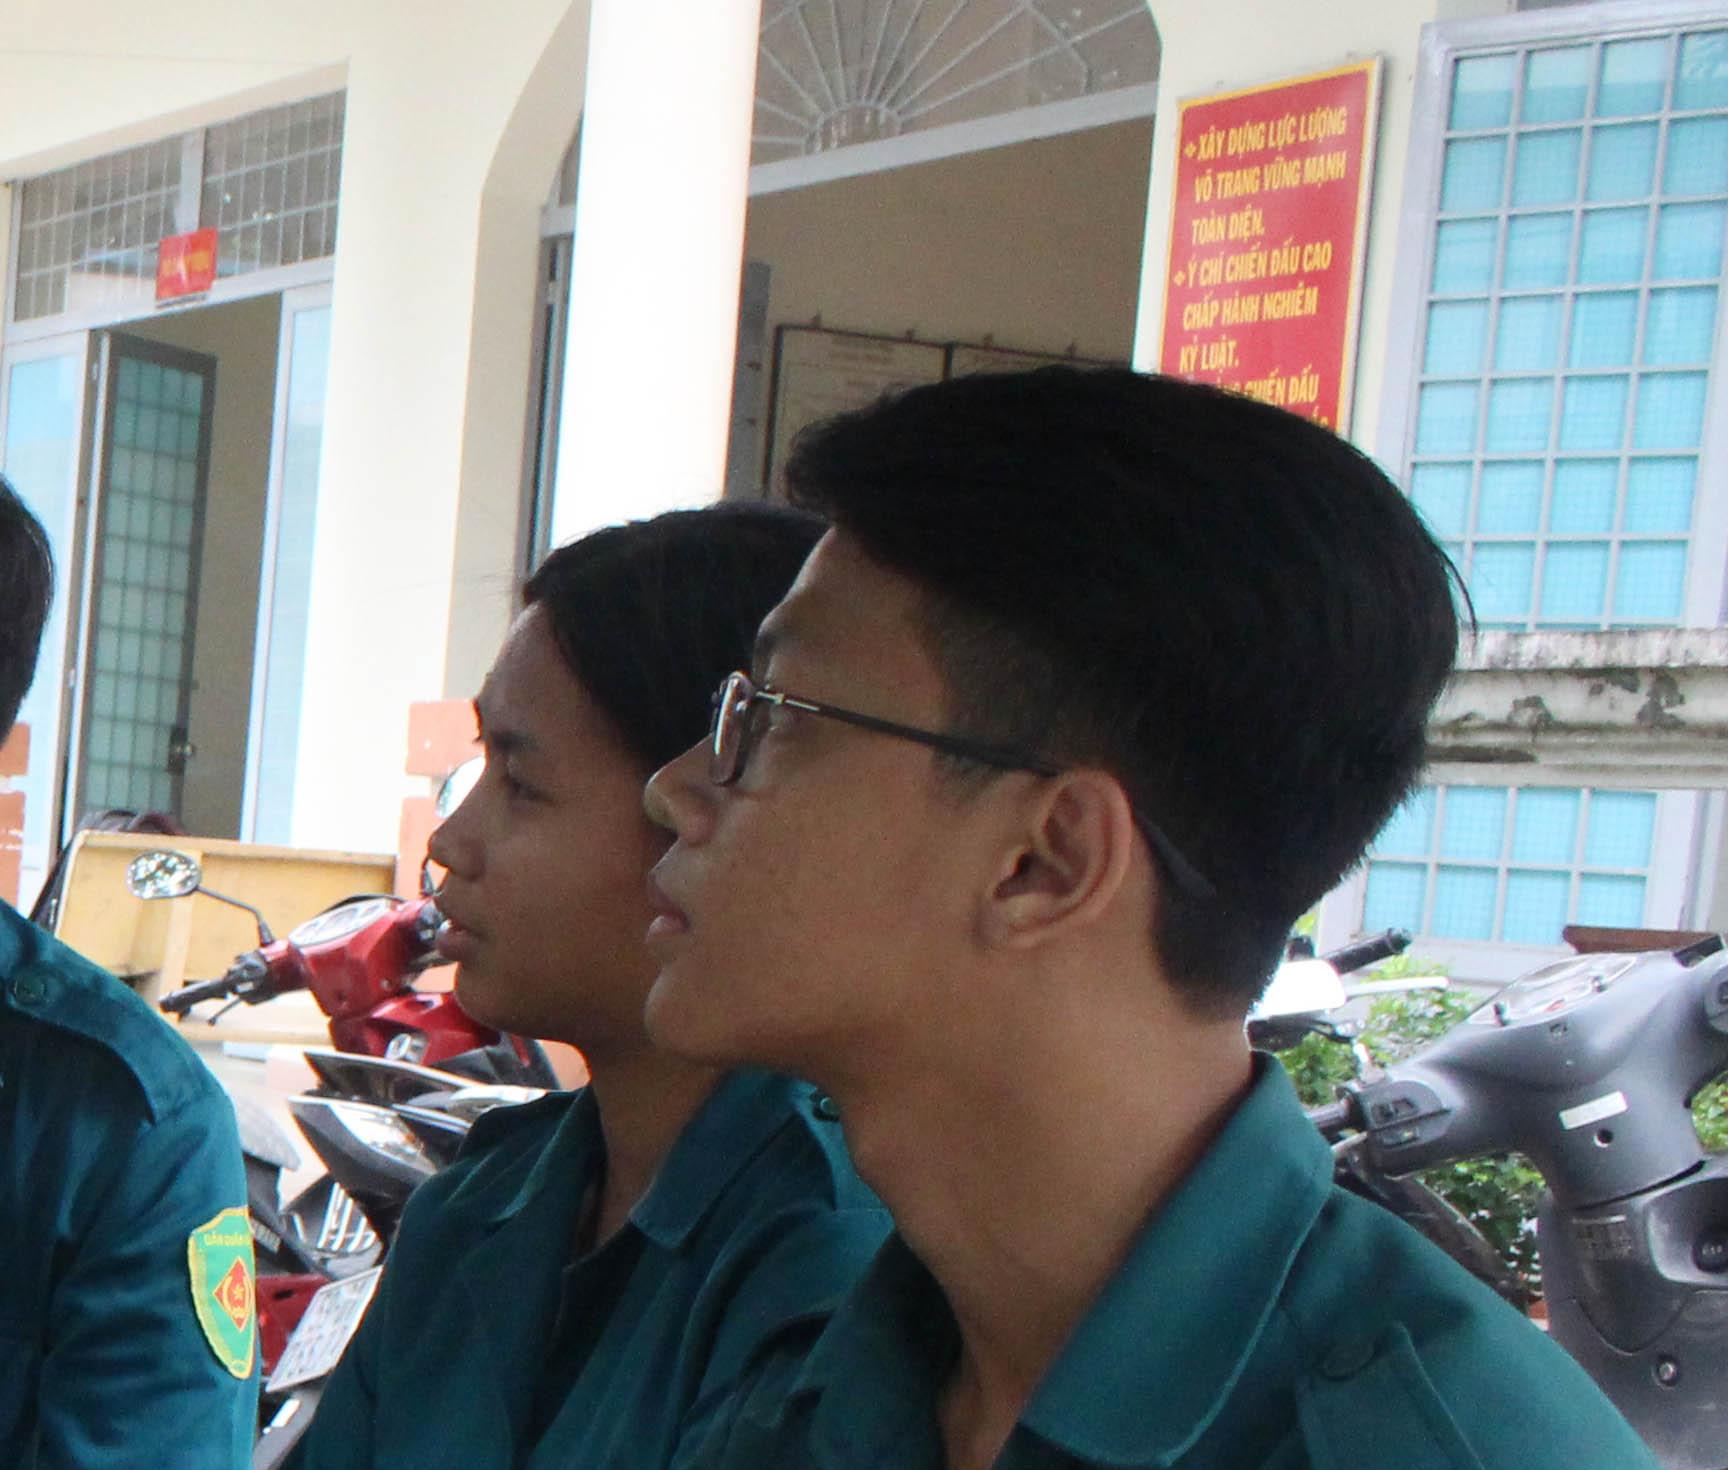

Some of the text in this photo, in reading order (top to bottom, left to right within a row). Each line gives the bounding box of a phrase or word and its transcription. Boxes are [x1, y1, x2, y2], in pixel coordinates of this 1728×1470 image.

[1197, 106, 1347, 161] XÂY DỰNG LỰC LƯỢNG
[1195, 169, 1213, 204] VÕ
[1216, 166, 1260, 200] TRANG
[1304, 151, 1346, 188] MẠNH
[1192, 209, 1227, 245] TOÀN
[1187, 237, 1333, 288] Ý CHÍ CHIẾN ĐẤU CAO
[1183, 280, 1319, 332] CHẤP HÀNH NGHIÊM
